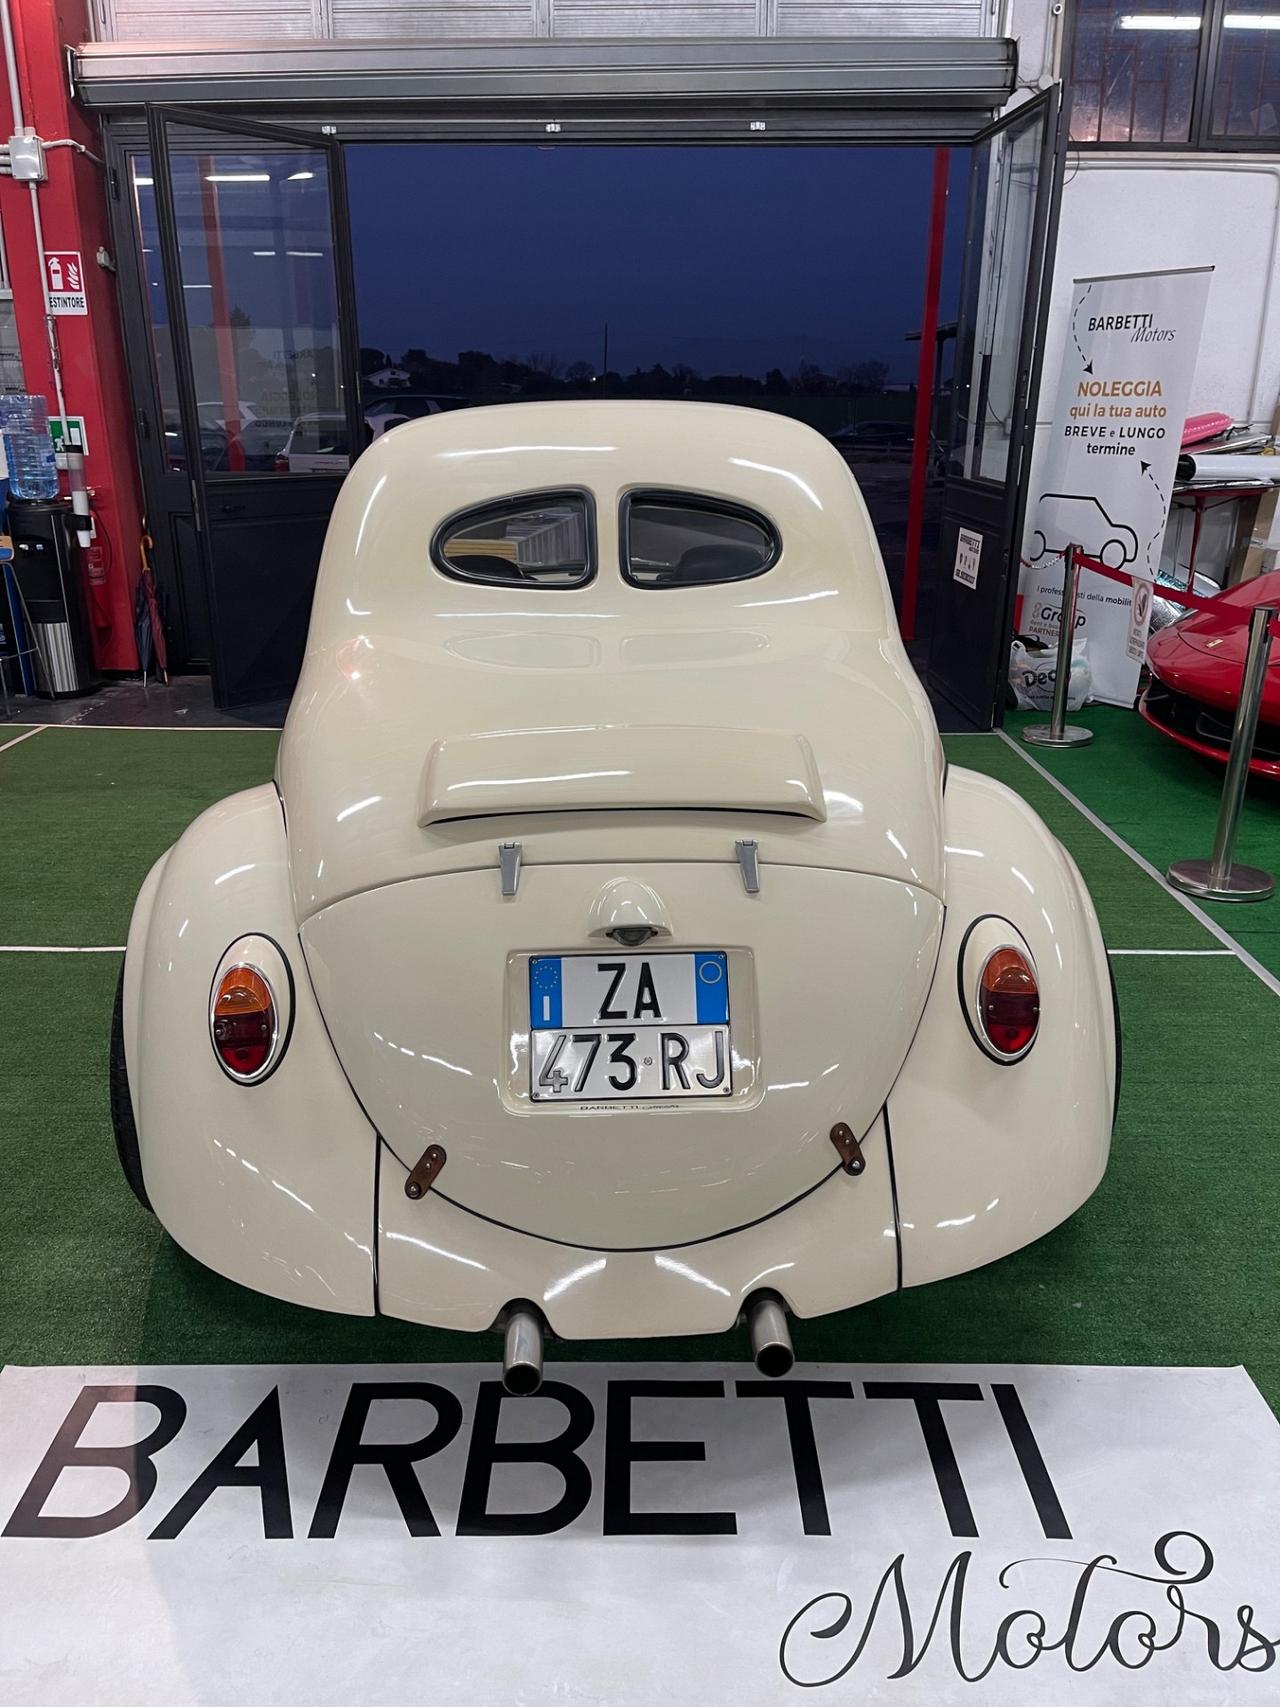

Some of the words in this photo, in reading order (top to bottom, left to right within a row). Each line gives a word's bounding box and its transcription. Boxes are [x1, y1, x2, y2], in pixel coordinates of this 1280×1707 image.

[49, 297, 85, 308] ESTINTORE
[1088, 314, 1154, 332] BARBETTI
[1130, 327, 1176, 343] Motors
[1077, 381, 1162, 397] NOLEGGIA
[1070, 403, 1091, 420] qui
[1094, 404, 1106, 418] la
[1109, 405, 1132, 418] tua
[1135, 406, 1167, 418] auto
[1065, 426, 1107, 437] BREVE
[1119, 427, 1166, 439] LUNGO
[1087, 443, 1136, 456] termine
[1087, 593, 1104, 602] della
[1105, 597, 1132, 606] mobilit
[597, 961, 662, 1020] ZA
[538, 1032, 638, 1093] 473
[659, 1031, 724, 1091] RJ
[2, 1380, 1073, 1540] BARBETTI
[780, 1531, 1280, 1687] Motors
